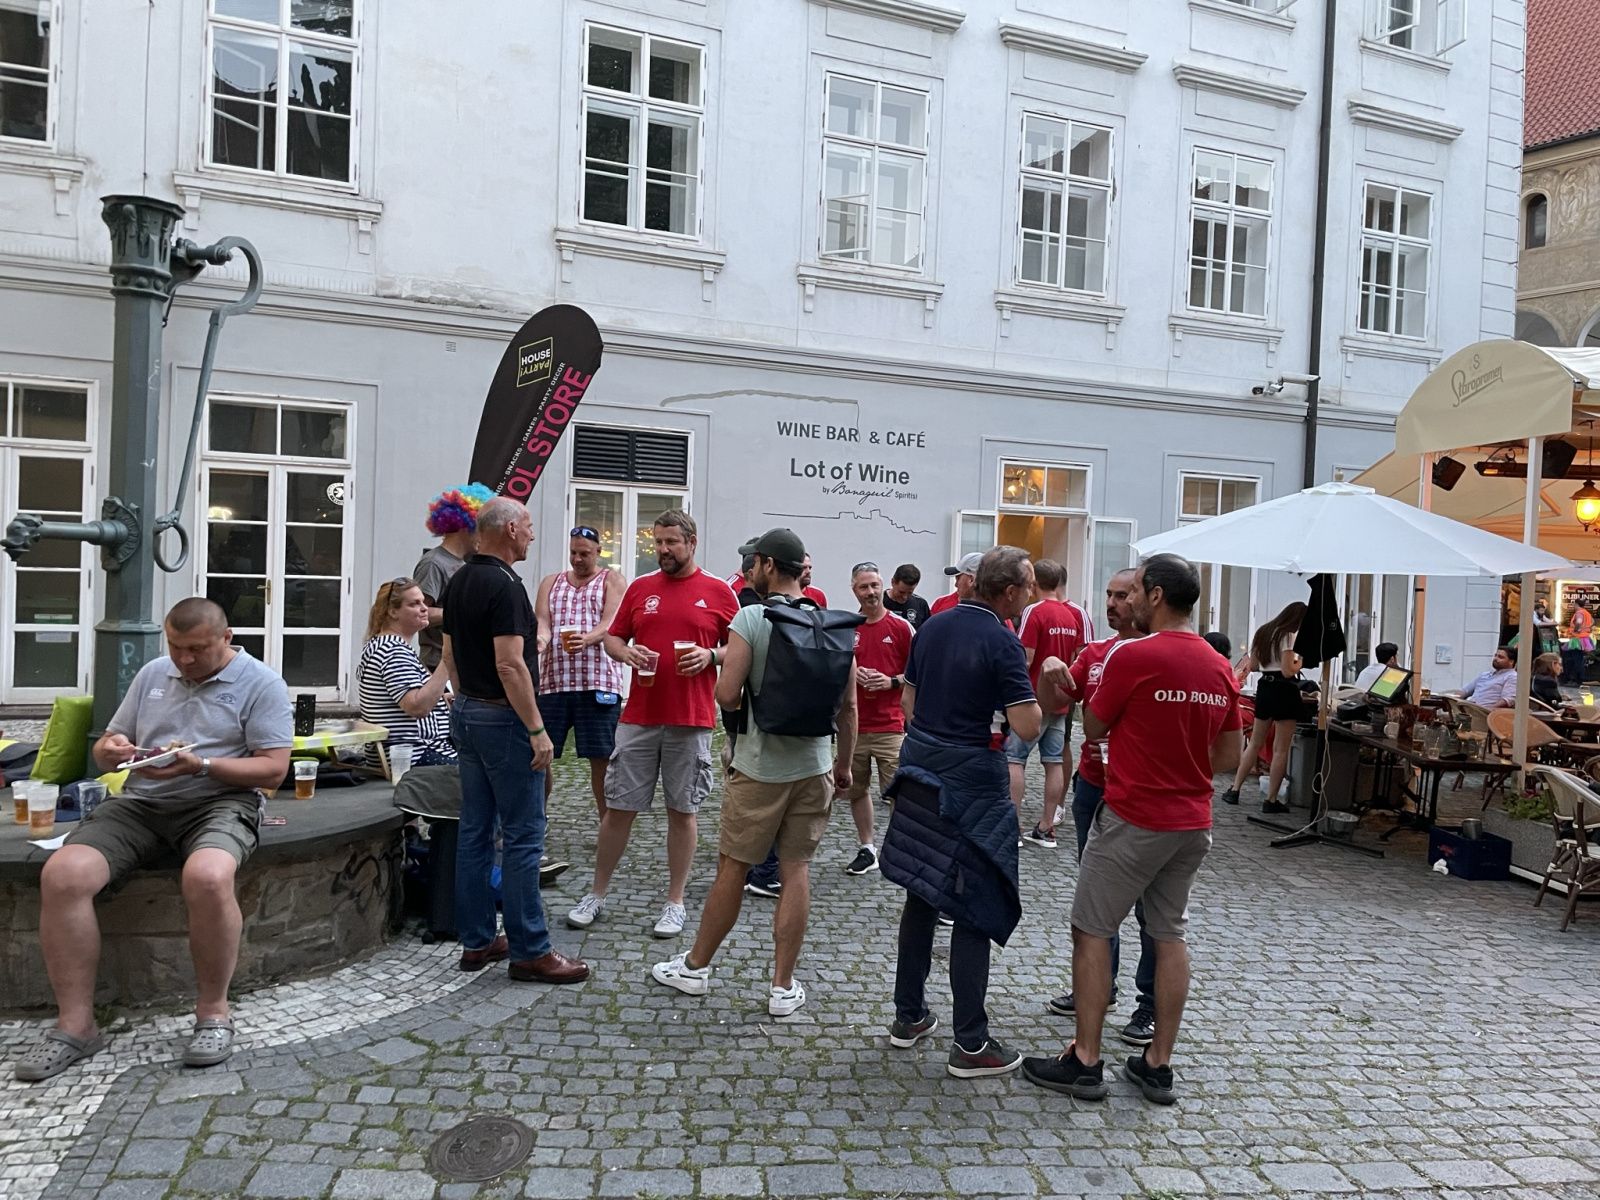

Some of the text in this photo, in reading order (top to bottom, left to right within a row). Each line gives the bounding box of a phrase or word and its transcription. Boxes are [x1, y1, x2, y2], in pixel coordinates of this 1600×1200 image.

[521, 348, 551, 366] HOUSE
[504, 447, 523, 476] SNACKS
[522, 416, 538, 442] GAMES
[538, 387, 552, 411] PARTY
[550, 362, 566, 386] DECOR
[527, 366, 592, 457] STORE
[776, 420, 926, 448] WINE BAR & CAFÉ
[790, 457, 910, 485] Lot of Wine
[822, 486, 830, 494] by
[1154, 689, 1228, 707] OLD BOARS
